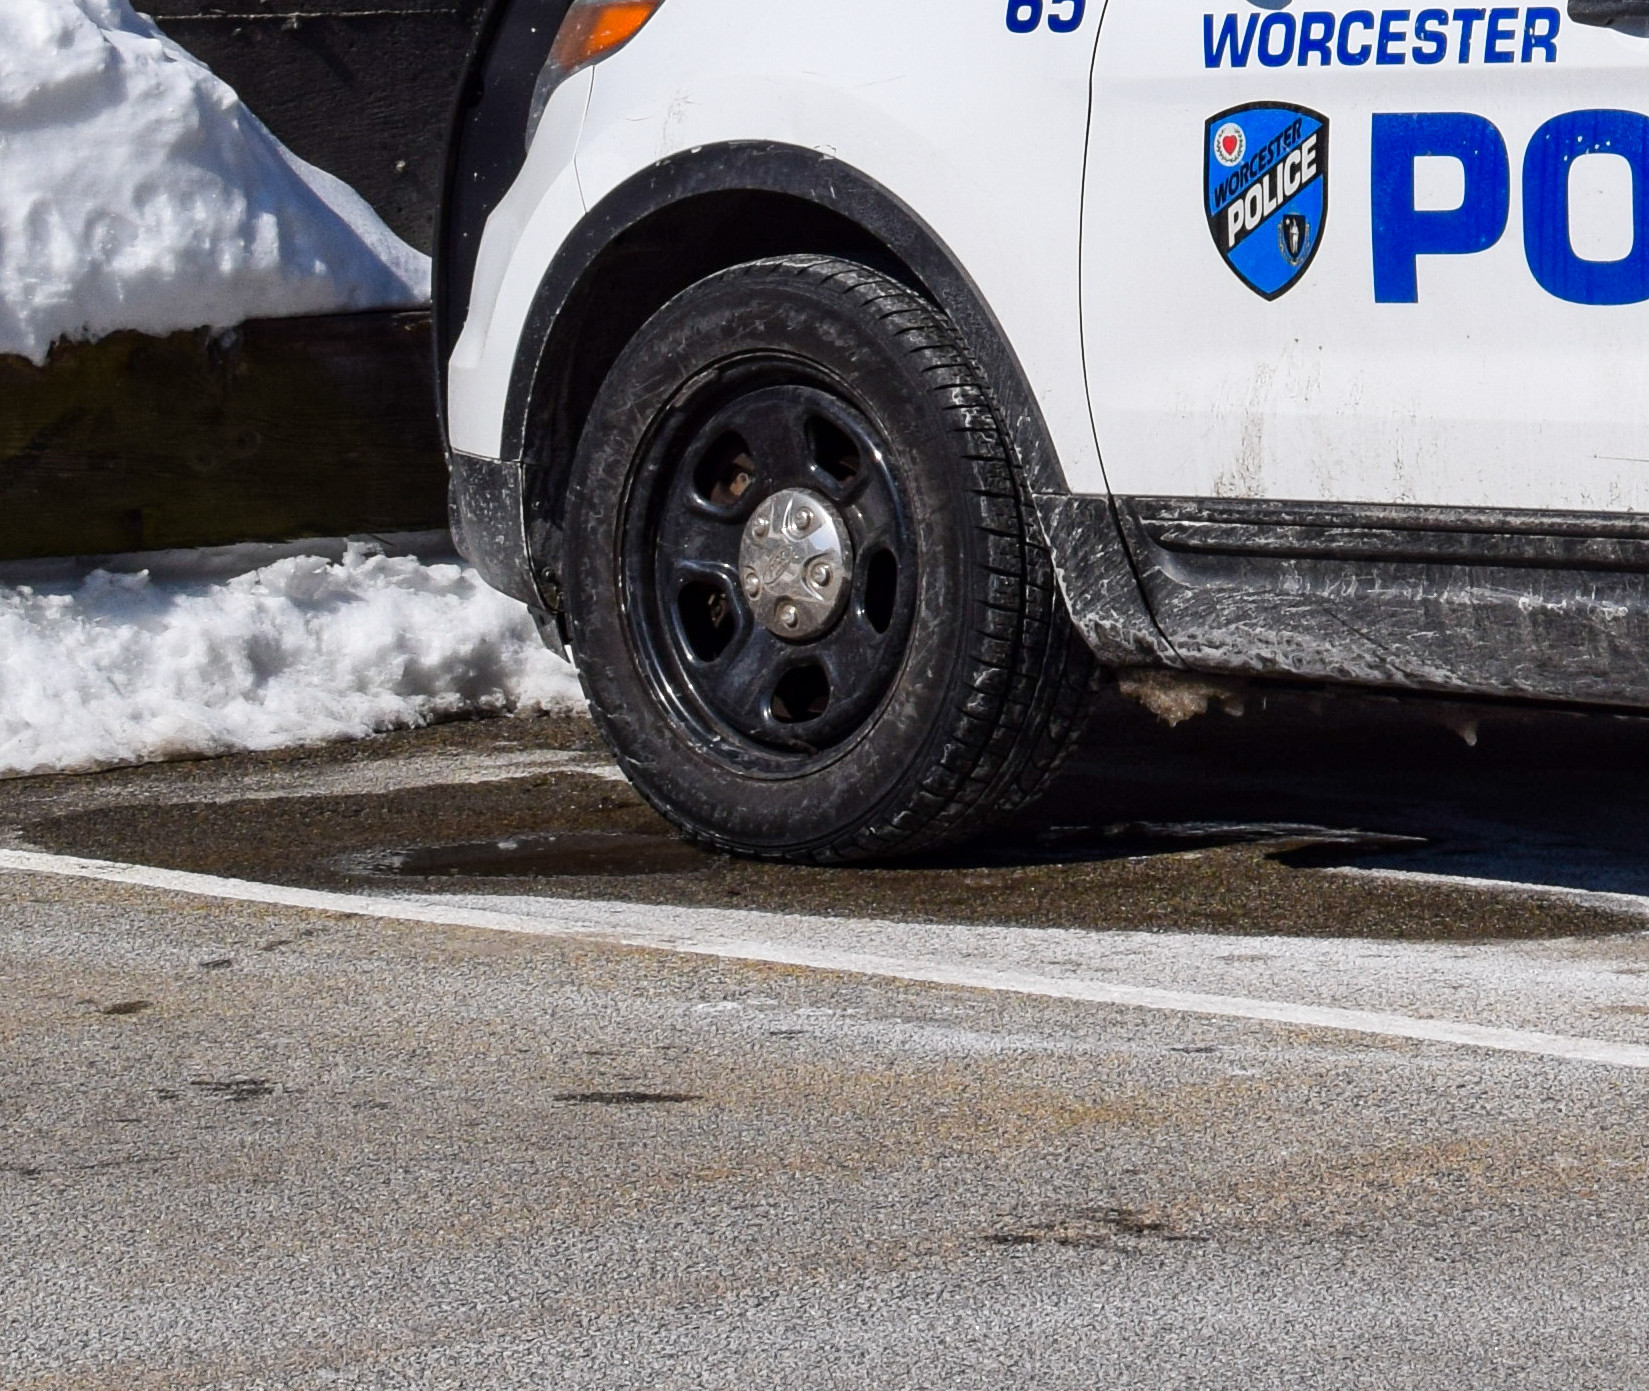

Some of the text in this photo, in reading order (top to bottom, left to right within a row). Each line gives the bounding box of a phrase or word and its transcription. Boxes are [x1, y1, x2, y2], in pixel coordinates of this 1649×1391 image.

[1203, 6, 1561, 68] WORCESTER
[1213, 117, 1303, 208] WORCESTER
[1227, 133, 1317, 248] POLICE
